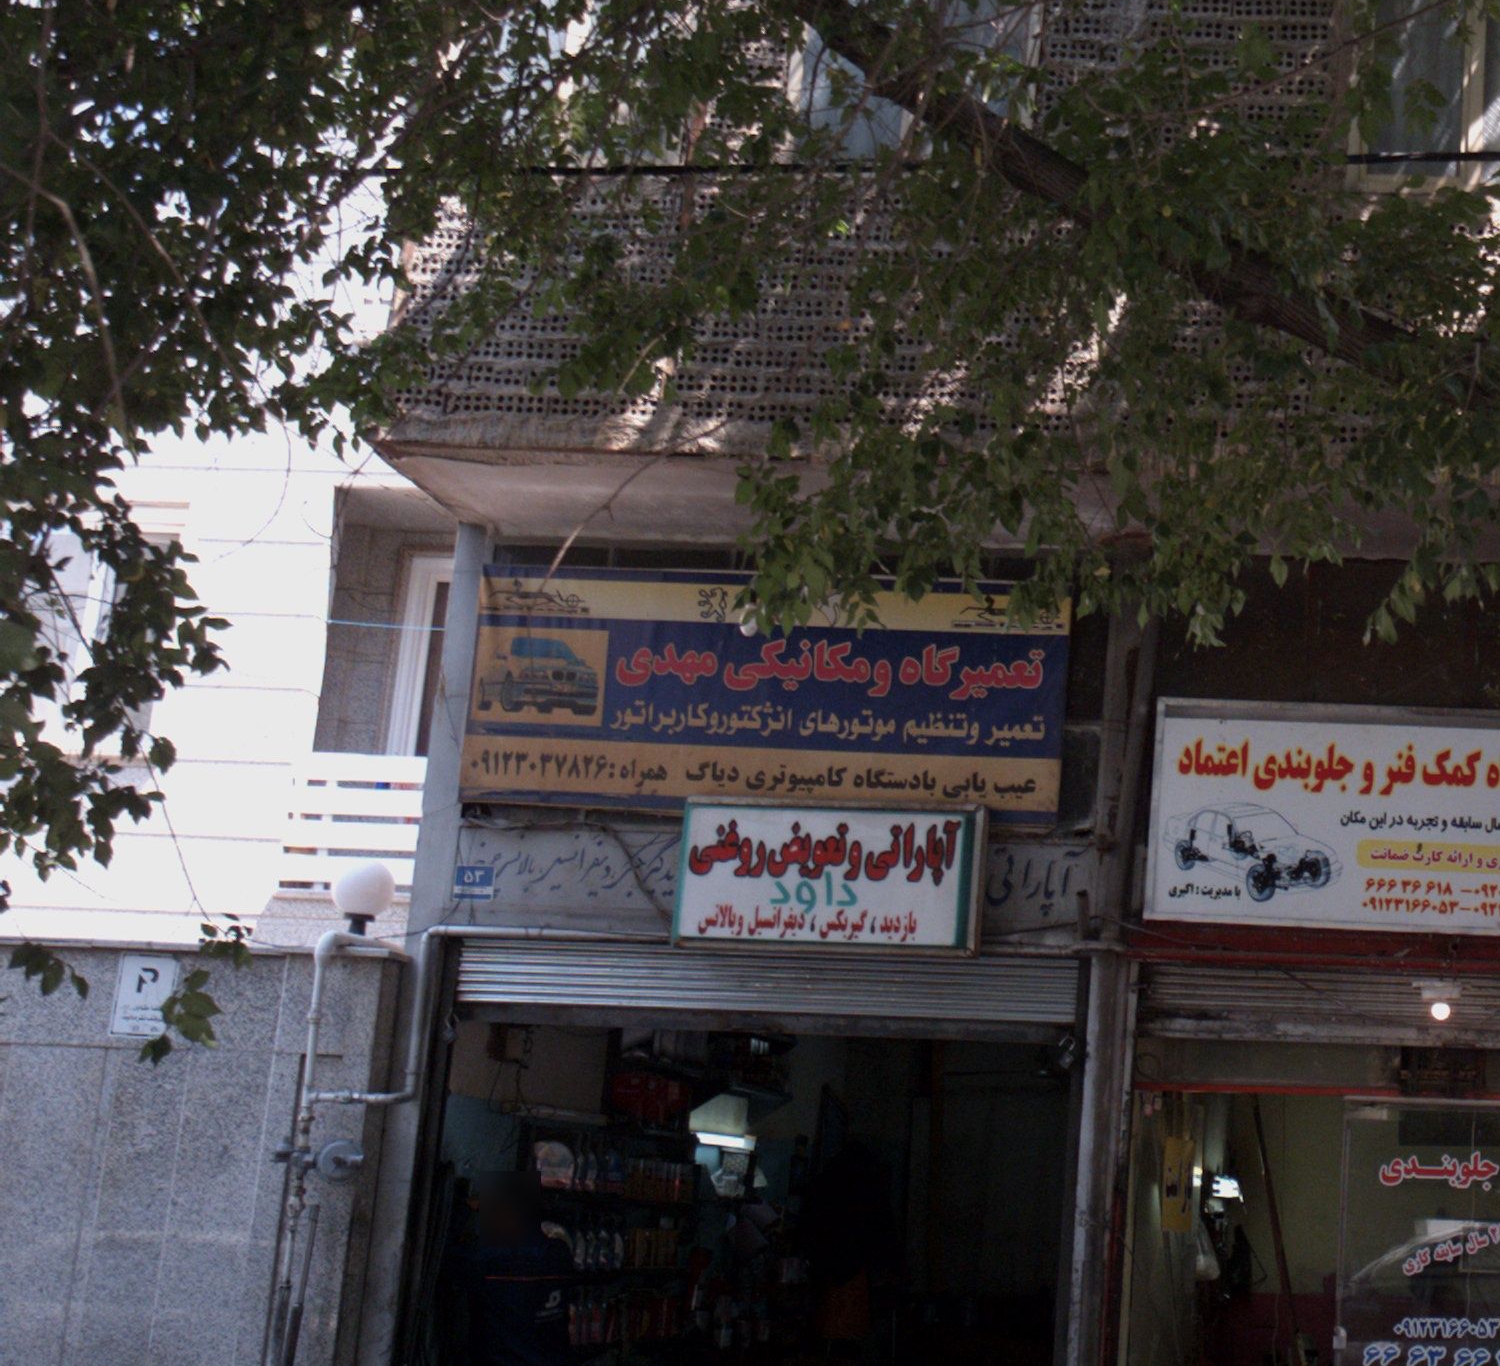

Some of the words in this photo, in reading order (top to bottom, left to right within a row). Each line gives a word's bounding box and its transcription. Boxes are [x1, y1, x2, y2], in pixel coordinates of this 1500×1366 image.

[616, 642, 719, 687] مهدی
[900, 643, 1046, 701] تعمیرگاه
[799, 707, 896, 742] موتورهای
[983, 714, 1046, 748] تعمیر
[469, 749, 607, 782] ۰۹۱۲۳۰۳۷۸۲۶
[1177, 737, 1250, 778] اعتماد
[1253, 741, 1354, 794] جلوبندی
[1380, 741, 1417, 796] فنر
[1422, 747, 1483, 788] کمک
[746, 763, 848, 795] کامپیوتری
[942, 771, 987, 800] یابی
[993, 778, 1037, 800] عیب
[1359, 759, 1375, 796] و
[1340, 810, 1367, 828] مکان
[1368, 811, 1388, 830] این
[1390, 814, 1404, 829] در
[1406, 815, 1439, 832] تجربه
[1451, 815, 1482, 833] سابقه
[690, 819, 767, 879] روغنی
[865, 819, 962, 887] آپاراتی
[1370, 847, 1410, 863] ضمانت
[463, 869, 485, 884] ۵۳
[770, 870, 859, 915] داود
[1168, 882, 1194, 899] اکبری
[1231, 882, 1242, 901] با
[748, 904, 806, 939] دیفرانسیل
[819, 909, 869, 941] گیربکس
[880, 910, 918, 943] بازدید
[1379, 1150, 1500, 1192] جلوبندی
[1434, 1239, 1464, 1263] سابقه
[1465, 1231, 1489, 1256] سال
[1402, 1247, 1430, 1276] کاری
